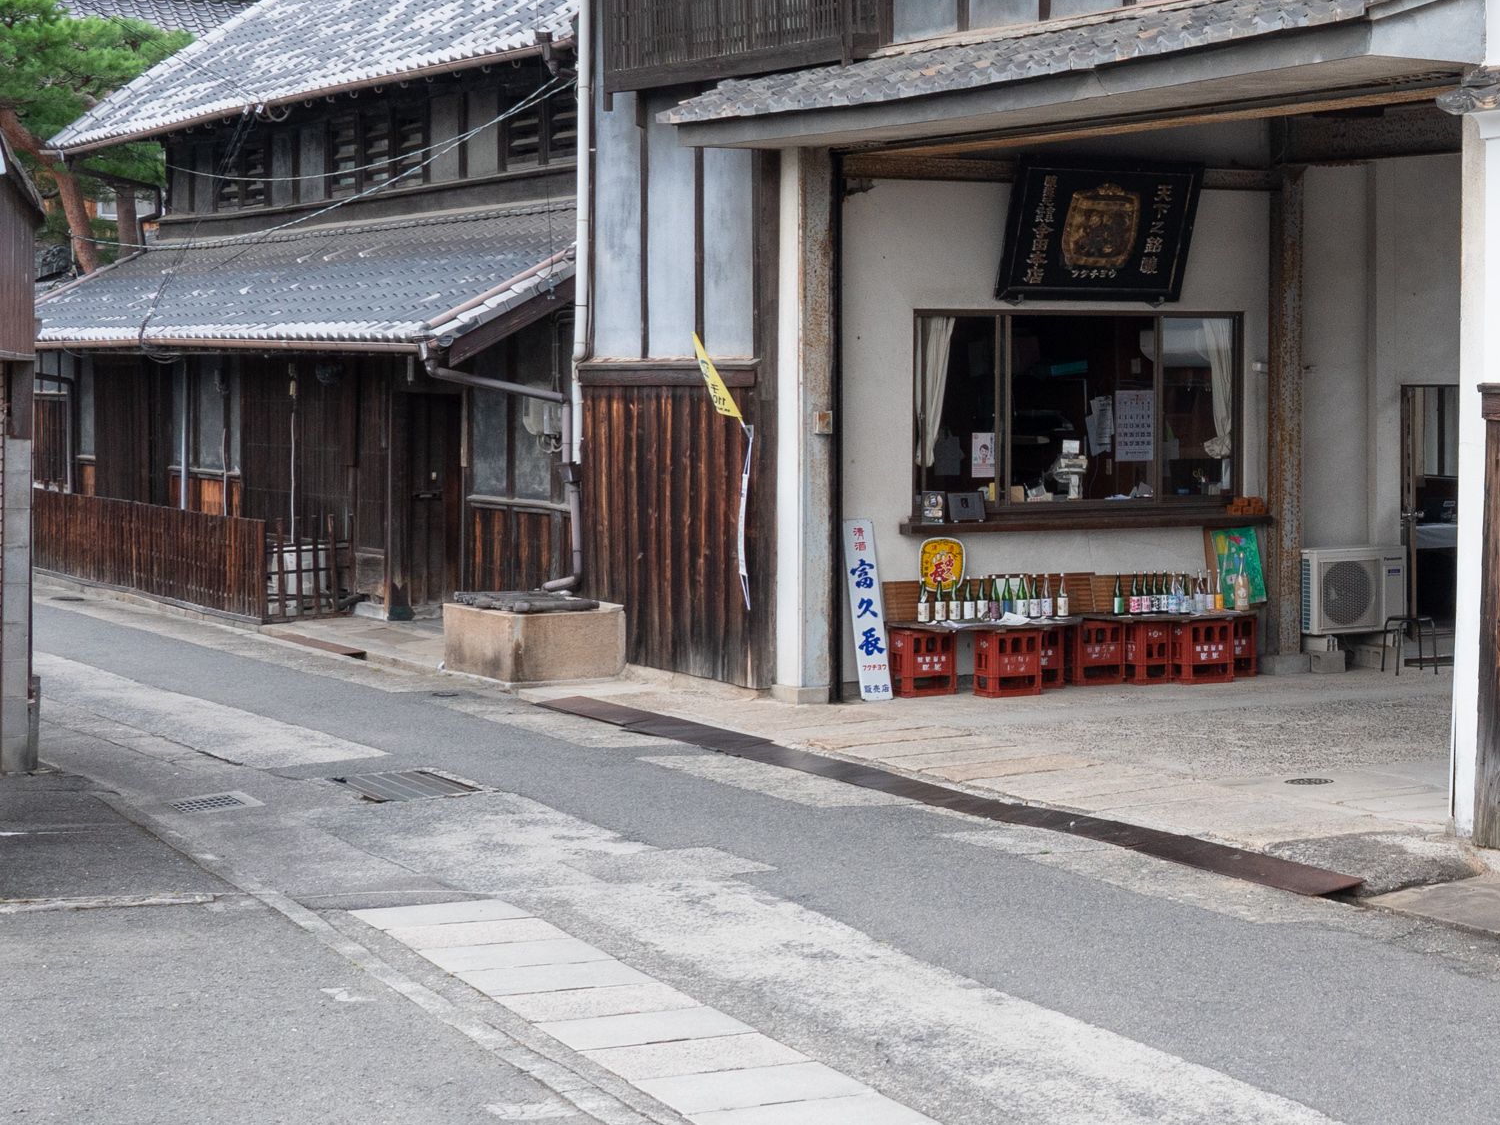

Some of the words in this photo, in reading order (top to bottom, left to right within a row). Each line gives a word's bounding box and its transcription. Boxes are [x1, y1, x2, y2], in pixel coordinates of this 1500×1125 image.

[853, 527, 867, 552] 清酒
[850, 558, 886, 656] 富久長
[863, 683, 890, 694] 販売店
